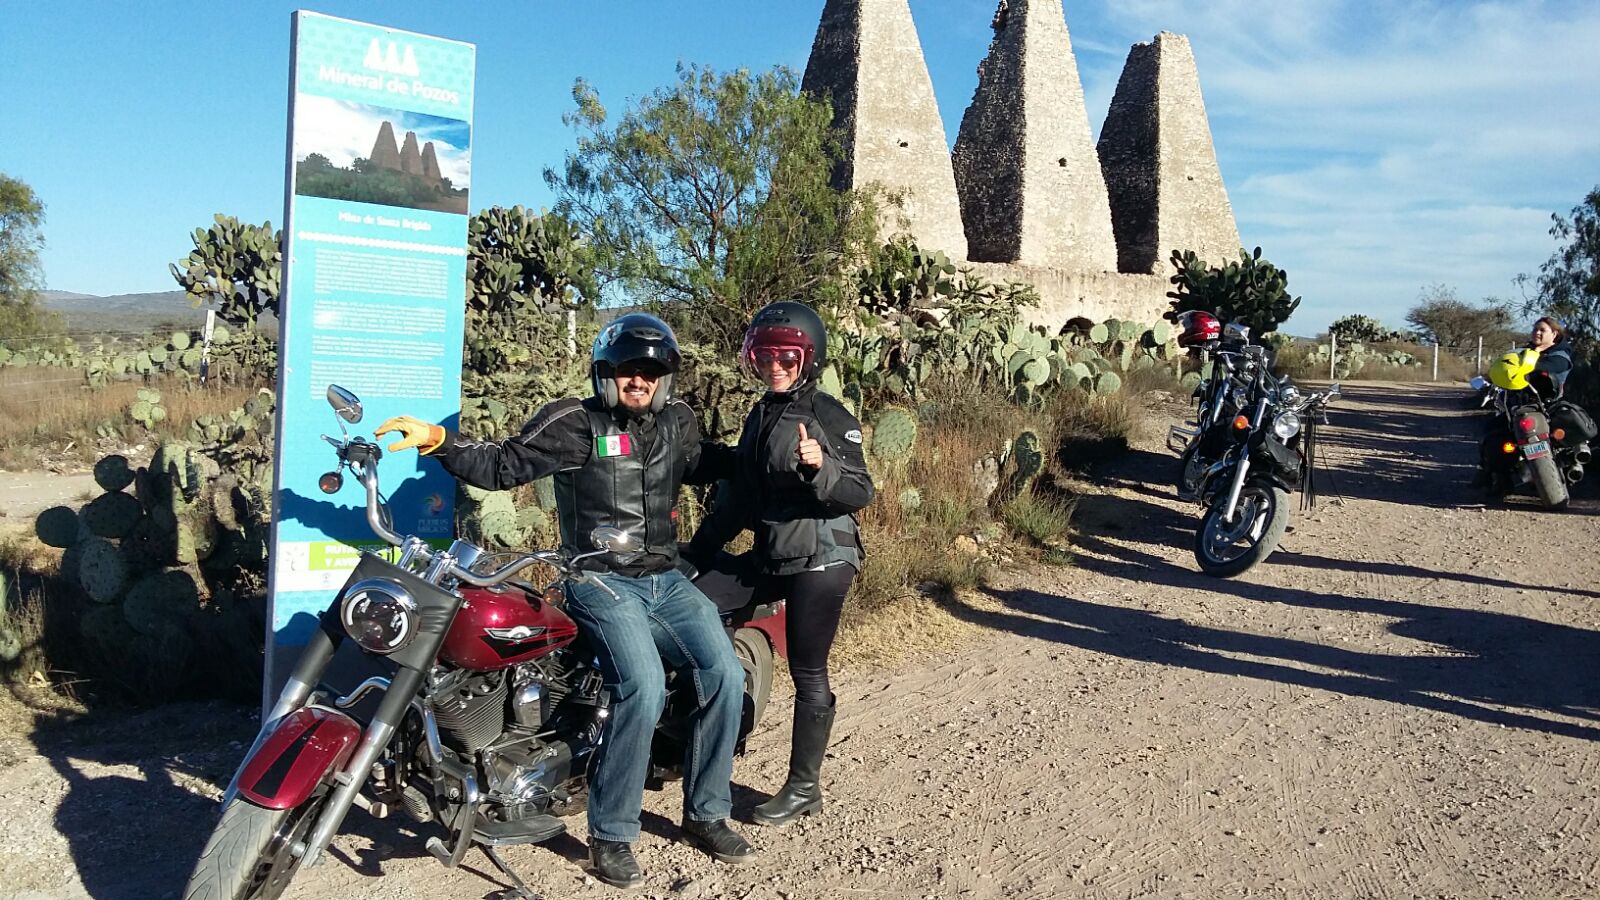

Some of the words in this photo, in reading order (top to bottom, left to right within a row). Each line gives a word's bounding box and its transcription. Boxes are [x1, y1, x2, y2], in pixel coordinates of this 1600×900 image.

[320, 64, 382, 90] Mineral
[386, 76, 409, 94] de
[412, 80, 459, 104] Pozos
